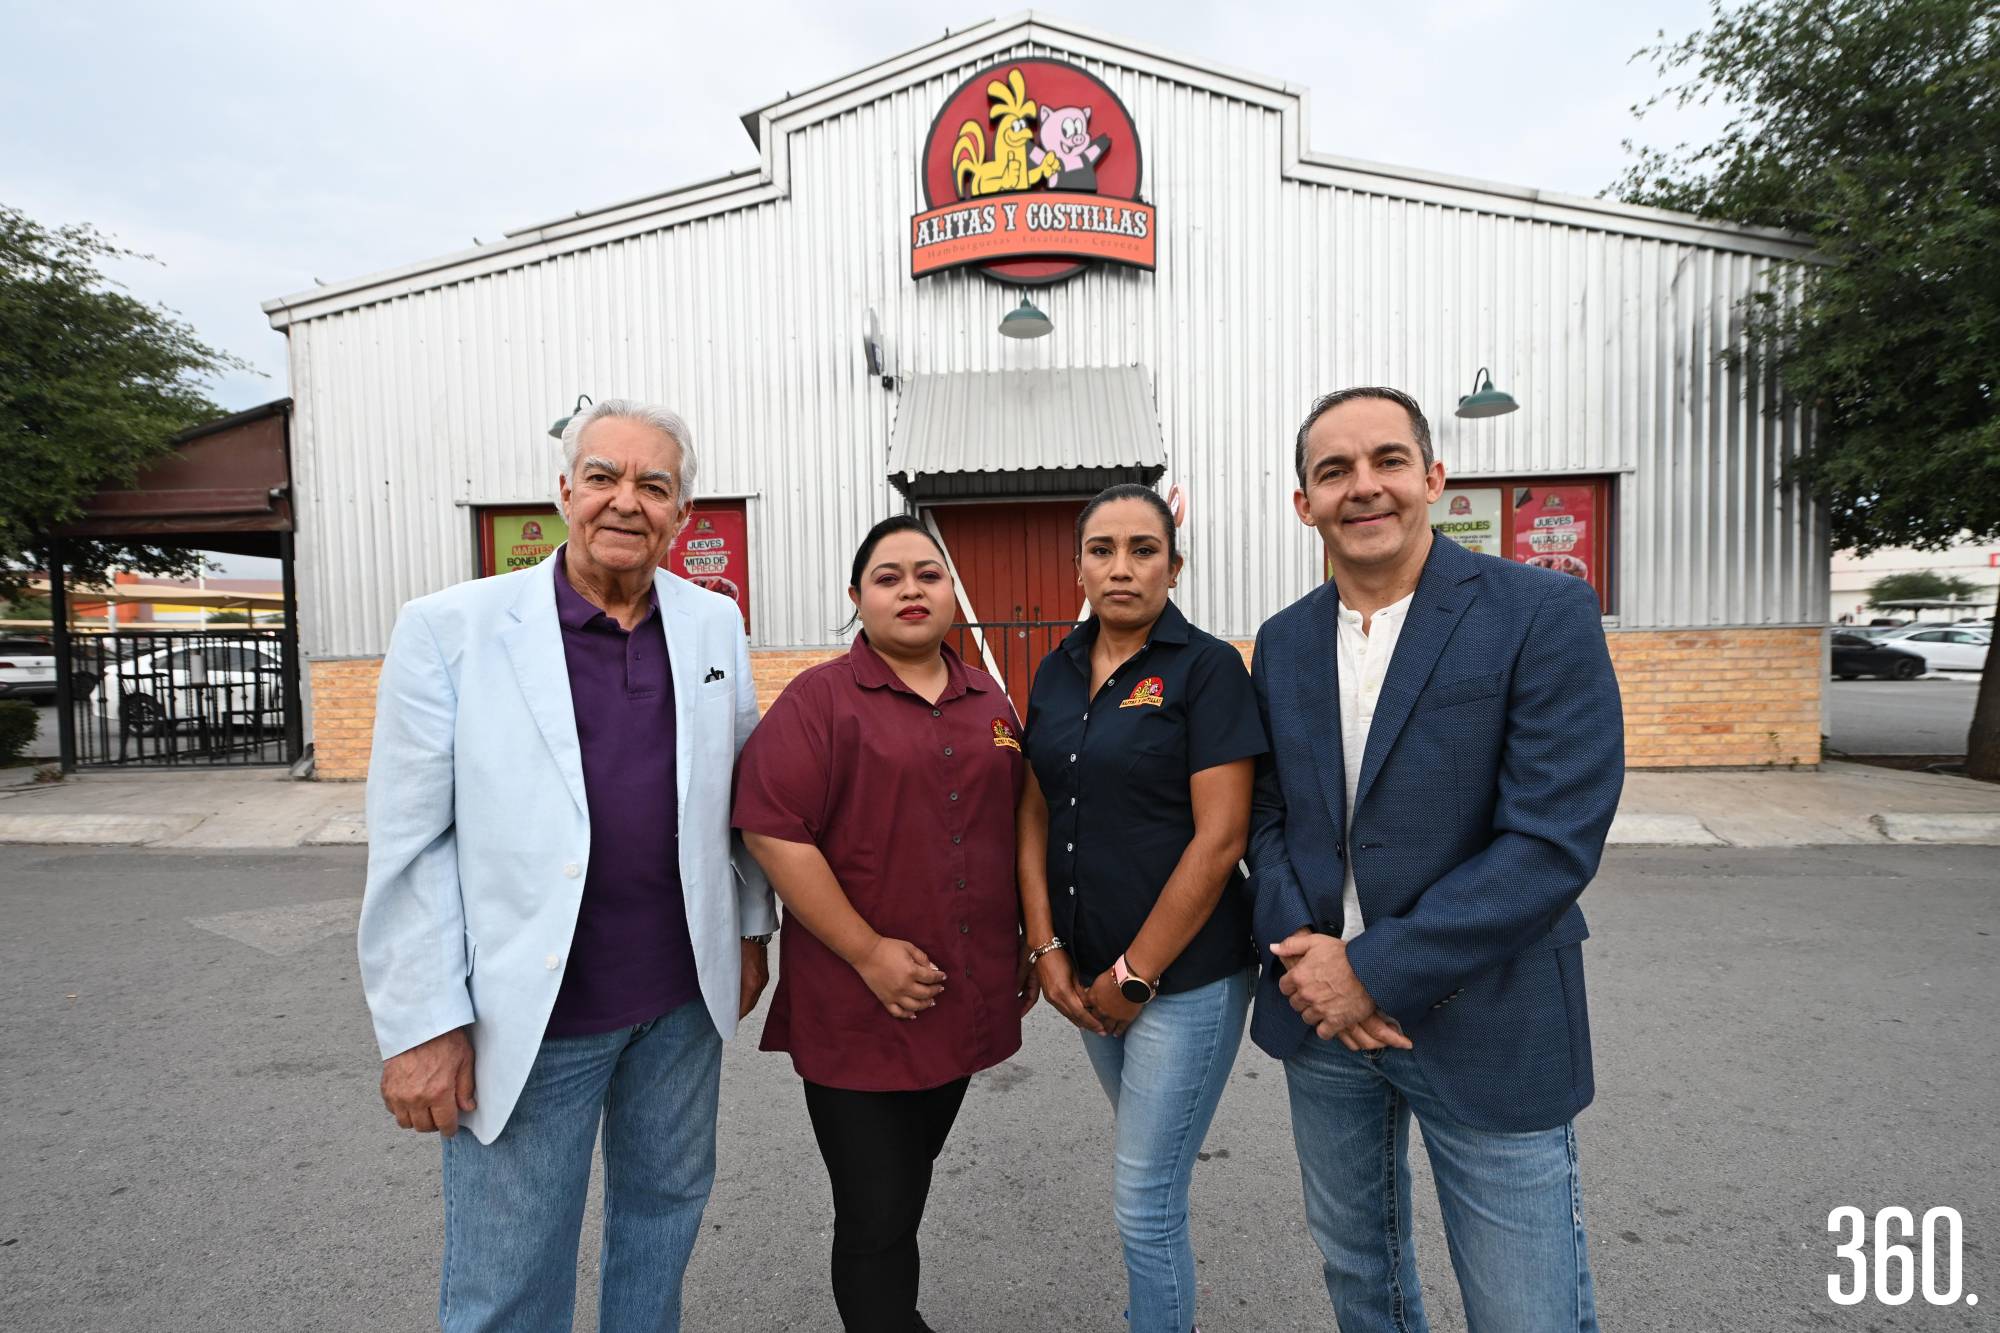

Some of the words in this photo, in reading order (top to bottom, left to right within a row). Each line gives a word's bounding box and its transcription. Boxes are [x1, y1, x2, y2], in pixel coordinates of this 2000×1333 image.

[915, 204, 997, 248] ALITAS
[1002, 203, 1019, 231] Y
[1025, 203, 1148, 238] COSTILLAS
[1536, 516, 1572, 527] JUEVES
[689, 539, 722, 549] JUEVES
[686, 557, 711, 566] MITAD
[713, 556, 726, 565] DE
